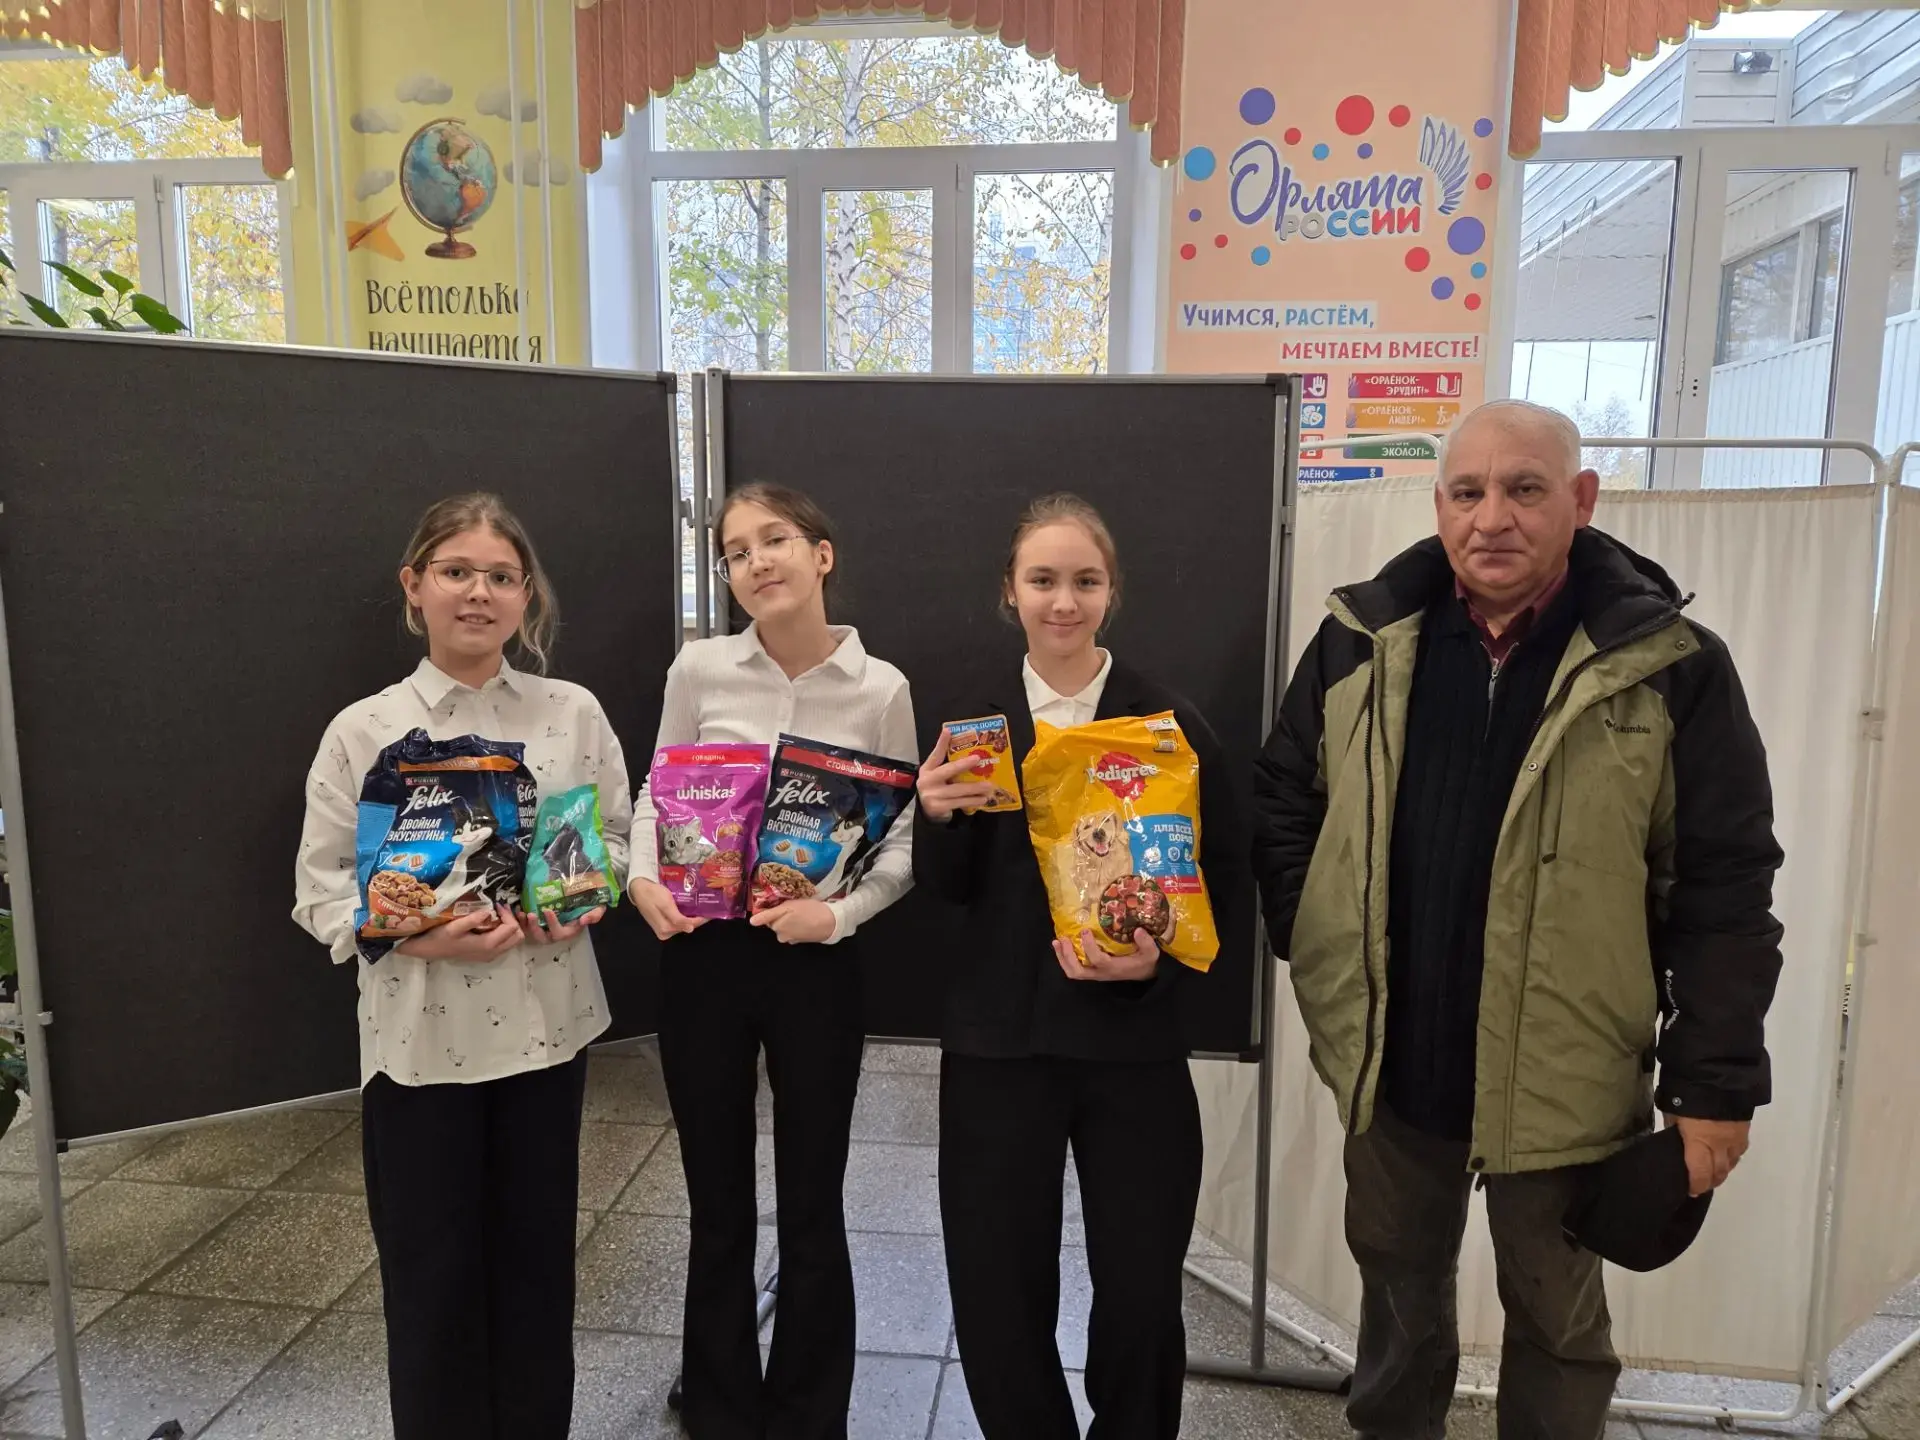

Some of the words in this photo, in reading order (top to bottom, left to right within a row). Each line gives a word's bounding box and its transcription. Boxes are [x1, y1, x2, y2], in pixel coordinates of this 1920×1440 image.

[1230, 139, 1423, 232] Орлята
[1279, 205, 1422, 240] РОССИИ
[366, 279, 413, 314] Всё
[1285, 304, 1374, 328] РАСТЁМ,
[1281, 342, 1382, 359] МЕЧТАЕМ
[1389, 336, 1479, 358] ВМЕСТЕ!
[1299, 468, 1339, 479] РЛЁНОК-
[676, 785, 737, 800] whiskas
[398, 817, 442, 830] ДВОЙНАЯ
[778, 809, 821, 829] ДВОЙНАЯ
[767, 820, 824, 843] ВКУСНЯТИНА
